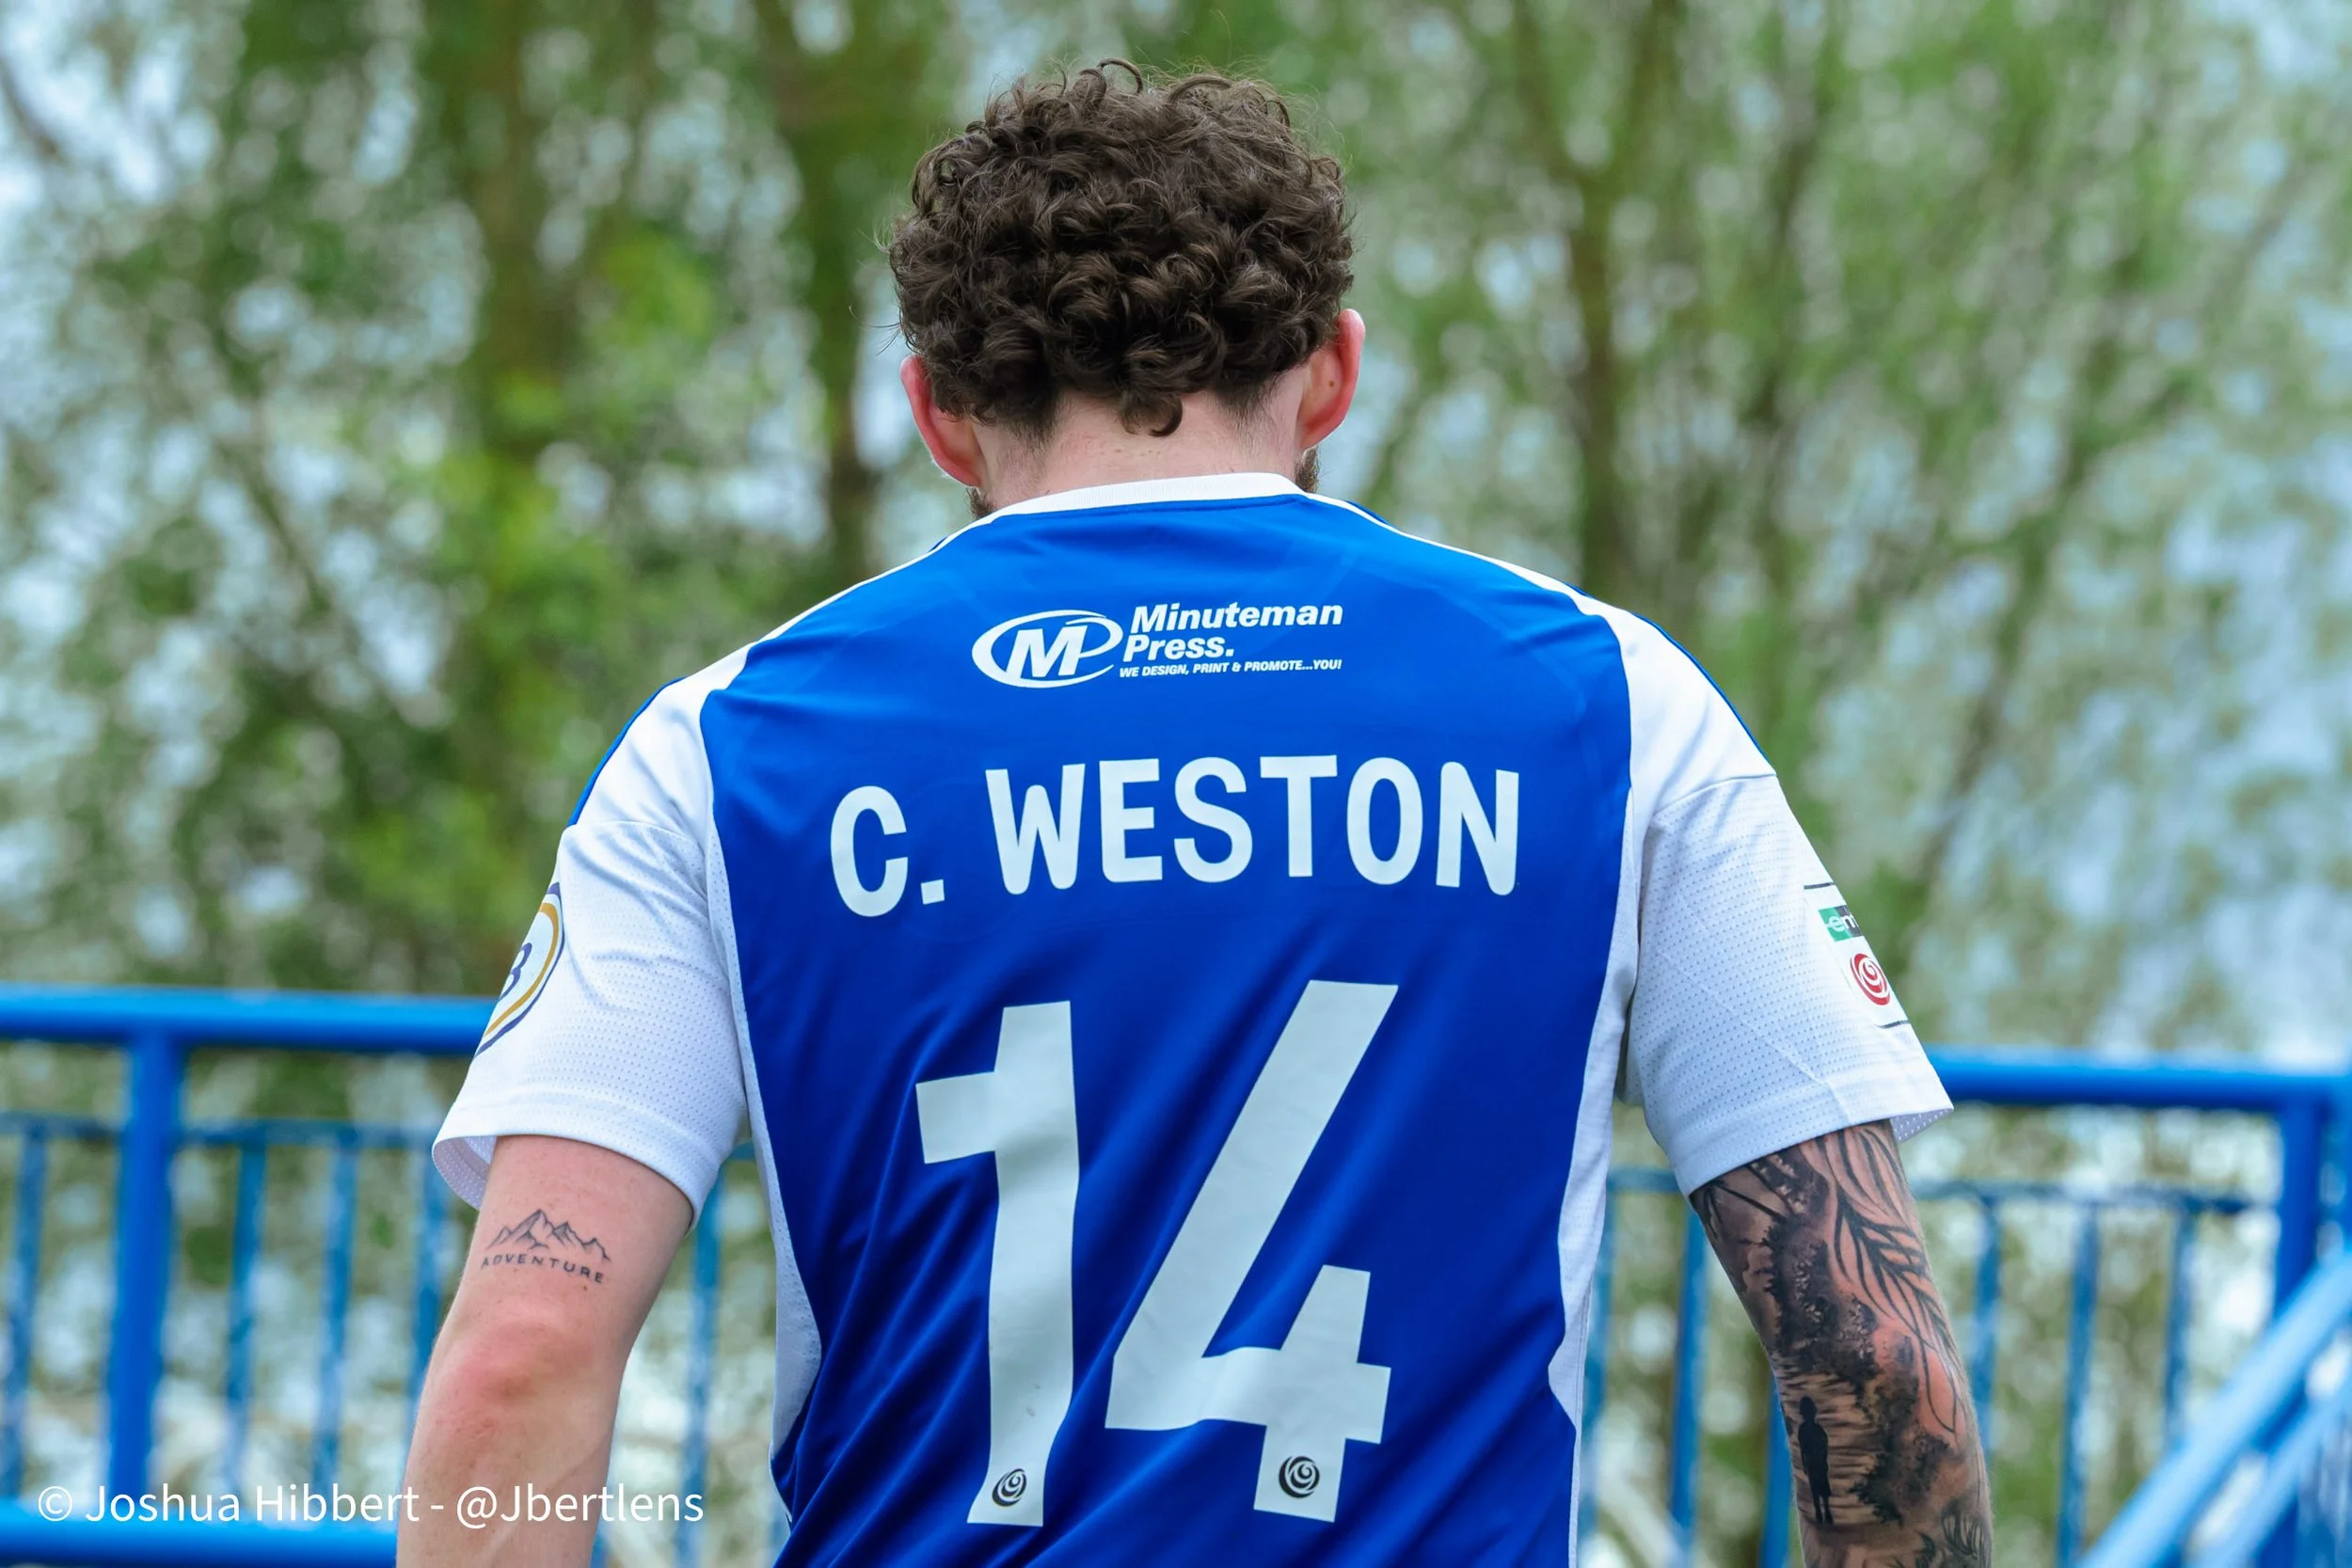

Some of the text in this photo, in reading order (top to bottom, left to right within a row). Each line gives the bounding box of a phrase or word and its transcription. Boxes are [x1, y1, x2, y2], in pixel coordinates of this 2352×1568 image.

[1131, 602, 1343, 634] Minuteman
[1122, 633, 1234, 662] Press.
[1120, 659, 1343, 677] WE DESIGN, PRINT & PROMOTE...YOU!
[830, 754, 1519, 917] C. WESTON
[481, 1253, 604, 1284] ADVENTURE
[915, 979, 1398, 1527] 14
